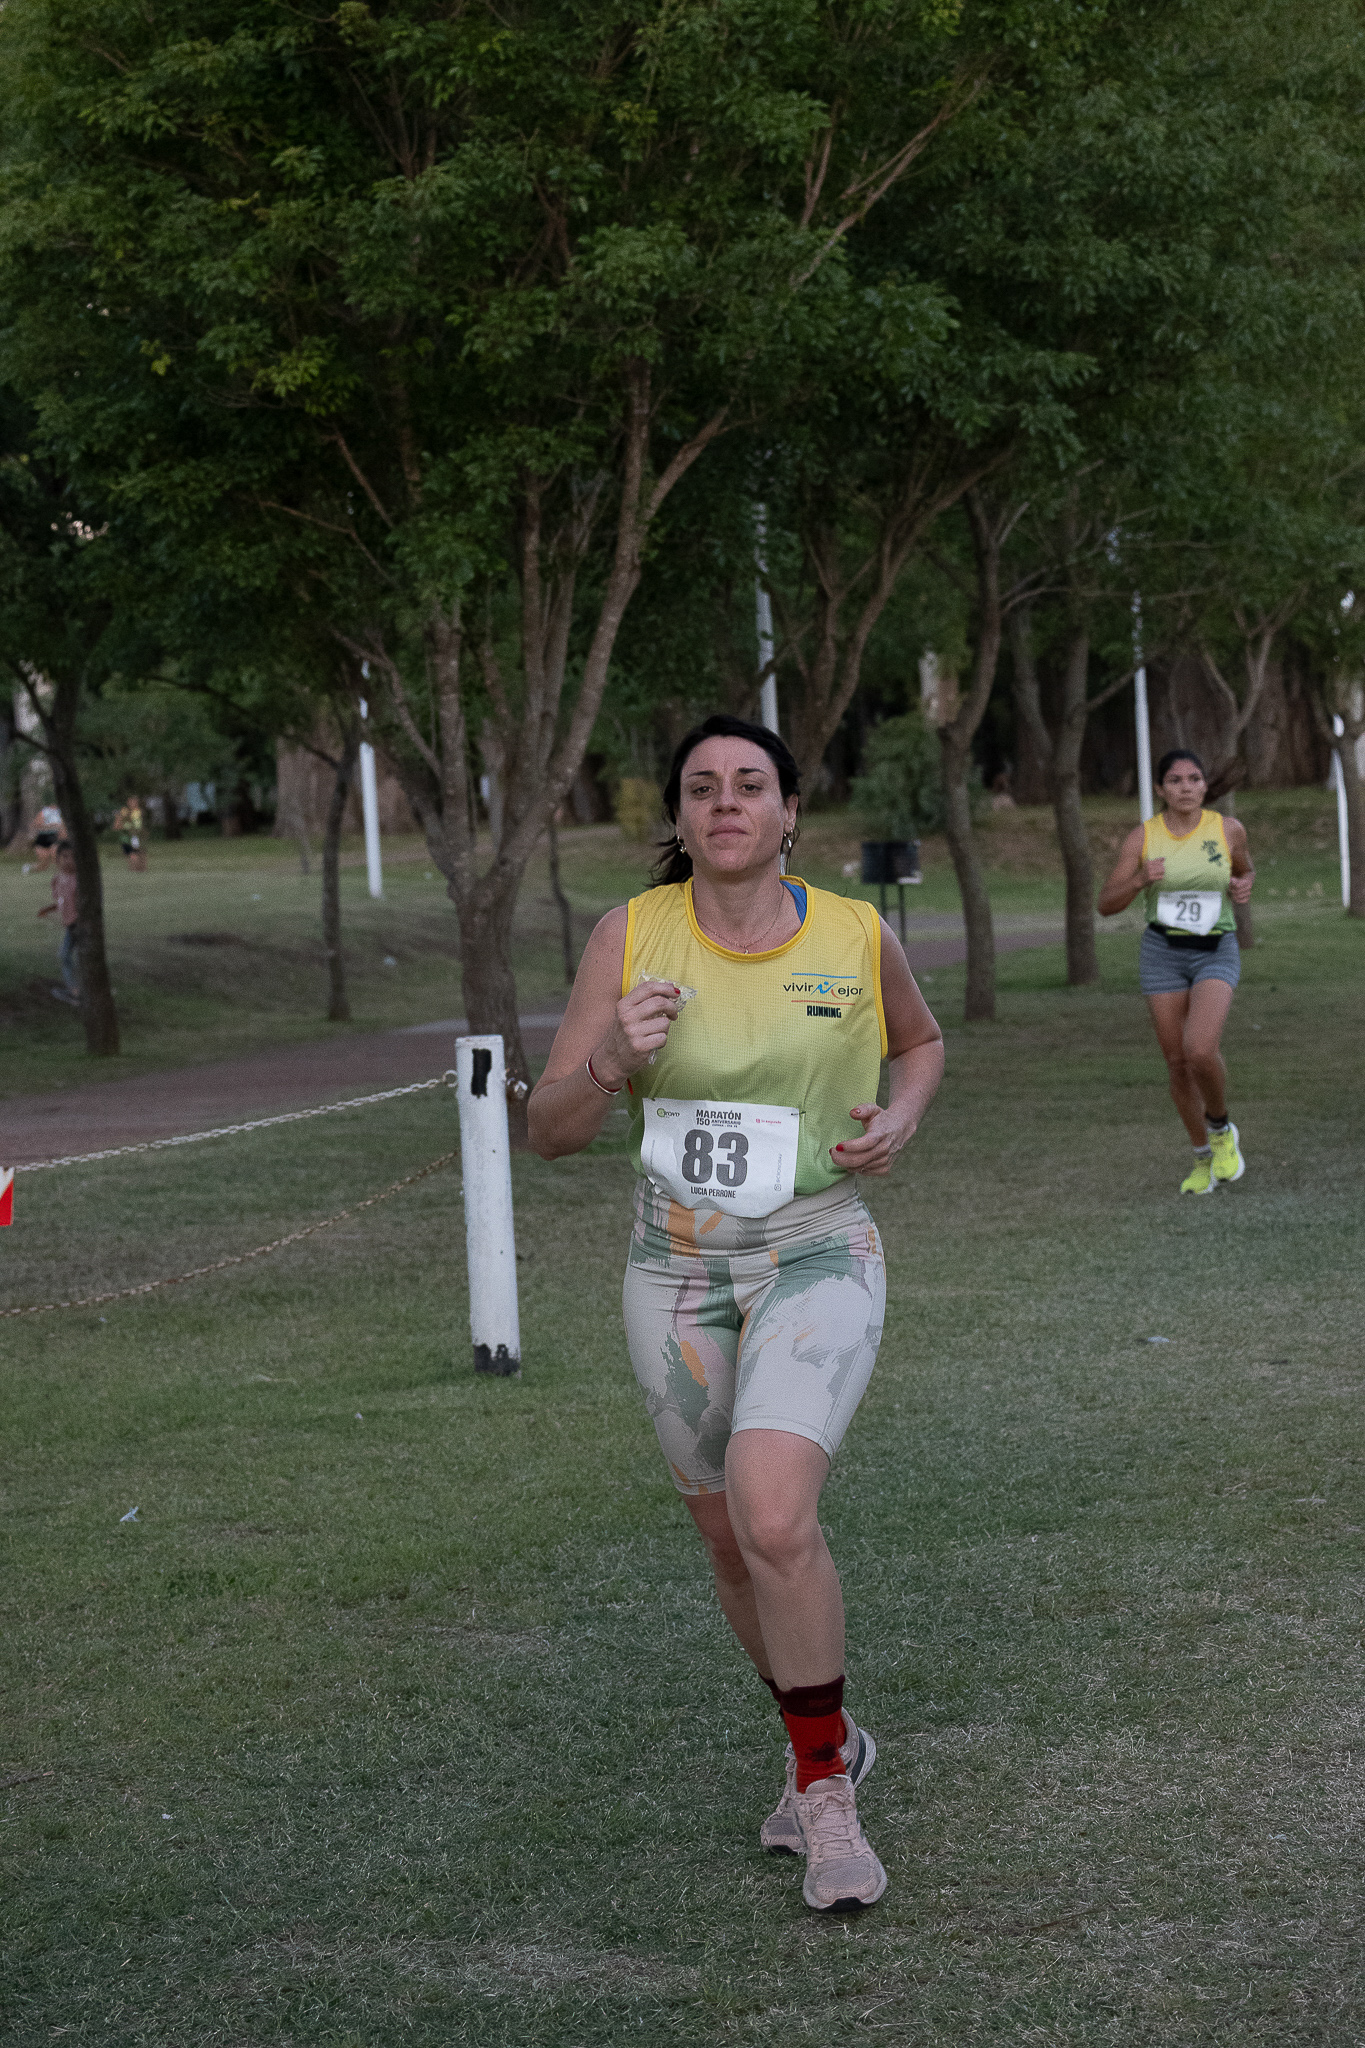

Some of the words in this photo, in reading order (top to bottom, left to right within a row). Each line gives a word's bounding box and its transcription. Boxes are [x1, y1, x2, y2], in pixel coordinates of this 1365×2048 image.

[1176, 901, 1201, 922] 29
[807, 1005, 842, 1018] RUNNING
[696, 1109, 742, 1120] MARATÓN
[696, 1118, 710, 1126] 150
[681, 1129, 749, 1188] 83
[690, 1186, 708, 1196] LUCIA
[708, 1188, 736, 1198] PERRONE
